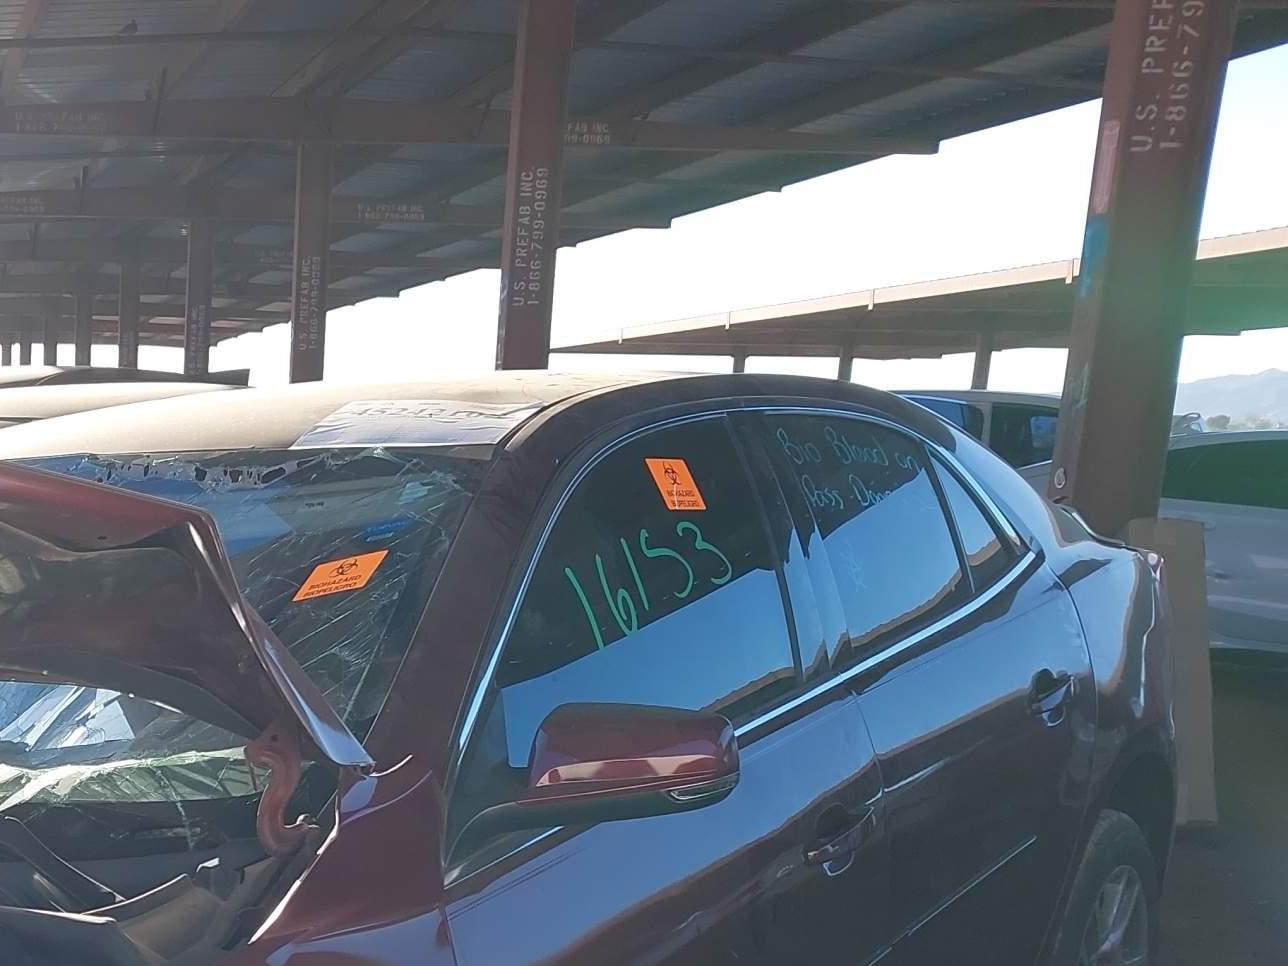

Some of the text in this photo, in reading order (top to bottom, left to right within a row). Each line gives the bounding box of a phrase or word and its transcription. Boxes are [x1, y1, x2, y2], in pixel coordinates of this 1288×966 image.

[1130, 93, 1161, 152] U.S.
[512, 165, 535, 306] U.S. PREFAB INC.
[527, 167, 549, 305] 1-866-799-0969
[300, 281, 311, 324] PREFAB
[309, 574, 362, 591] BIOHAZARD
[564, 521, 733, 650] 16153
